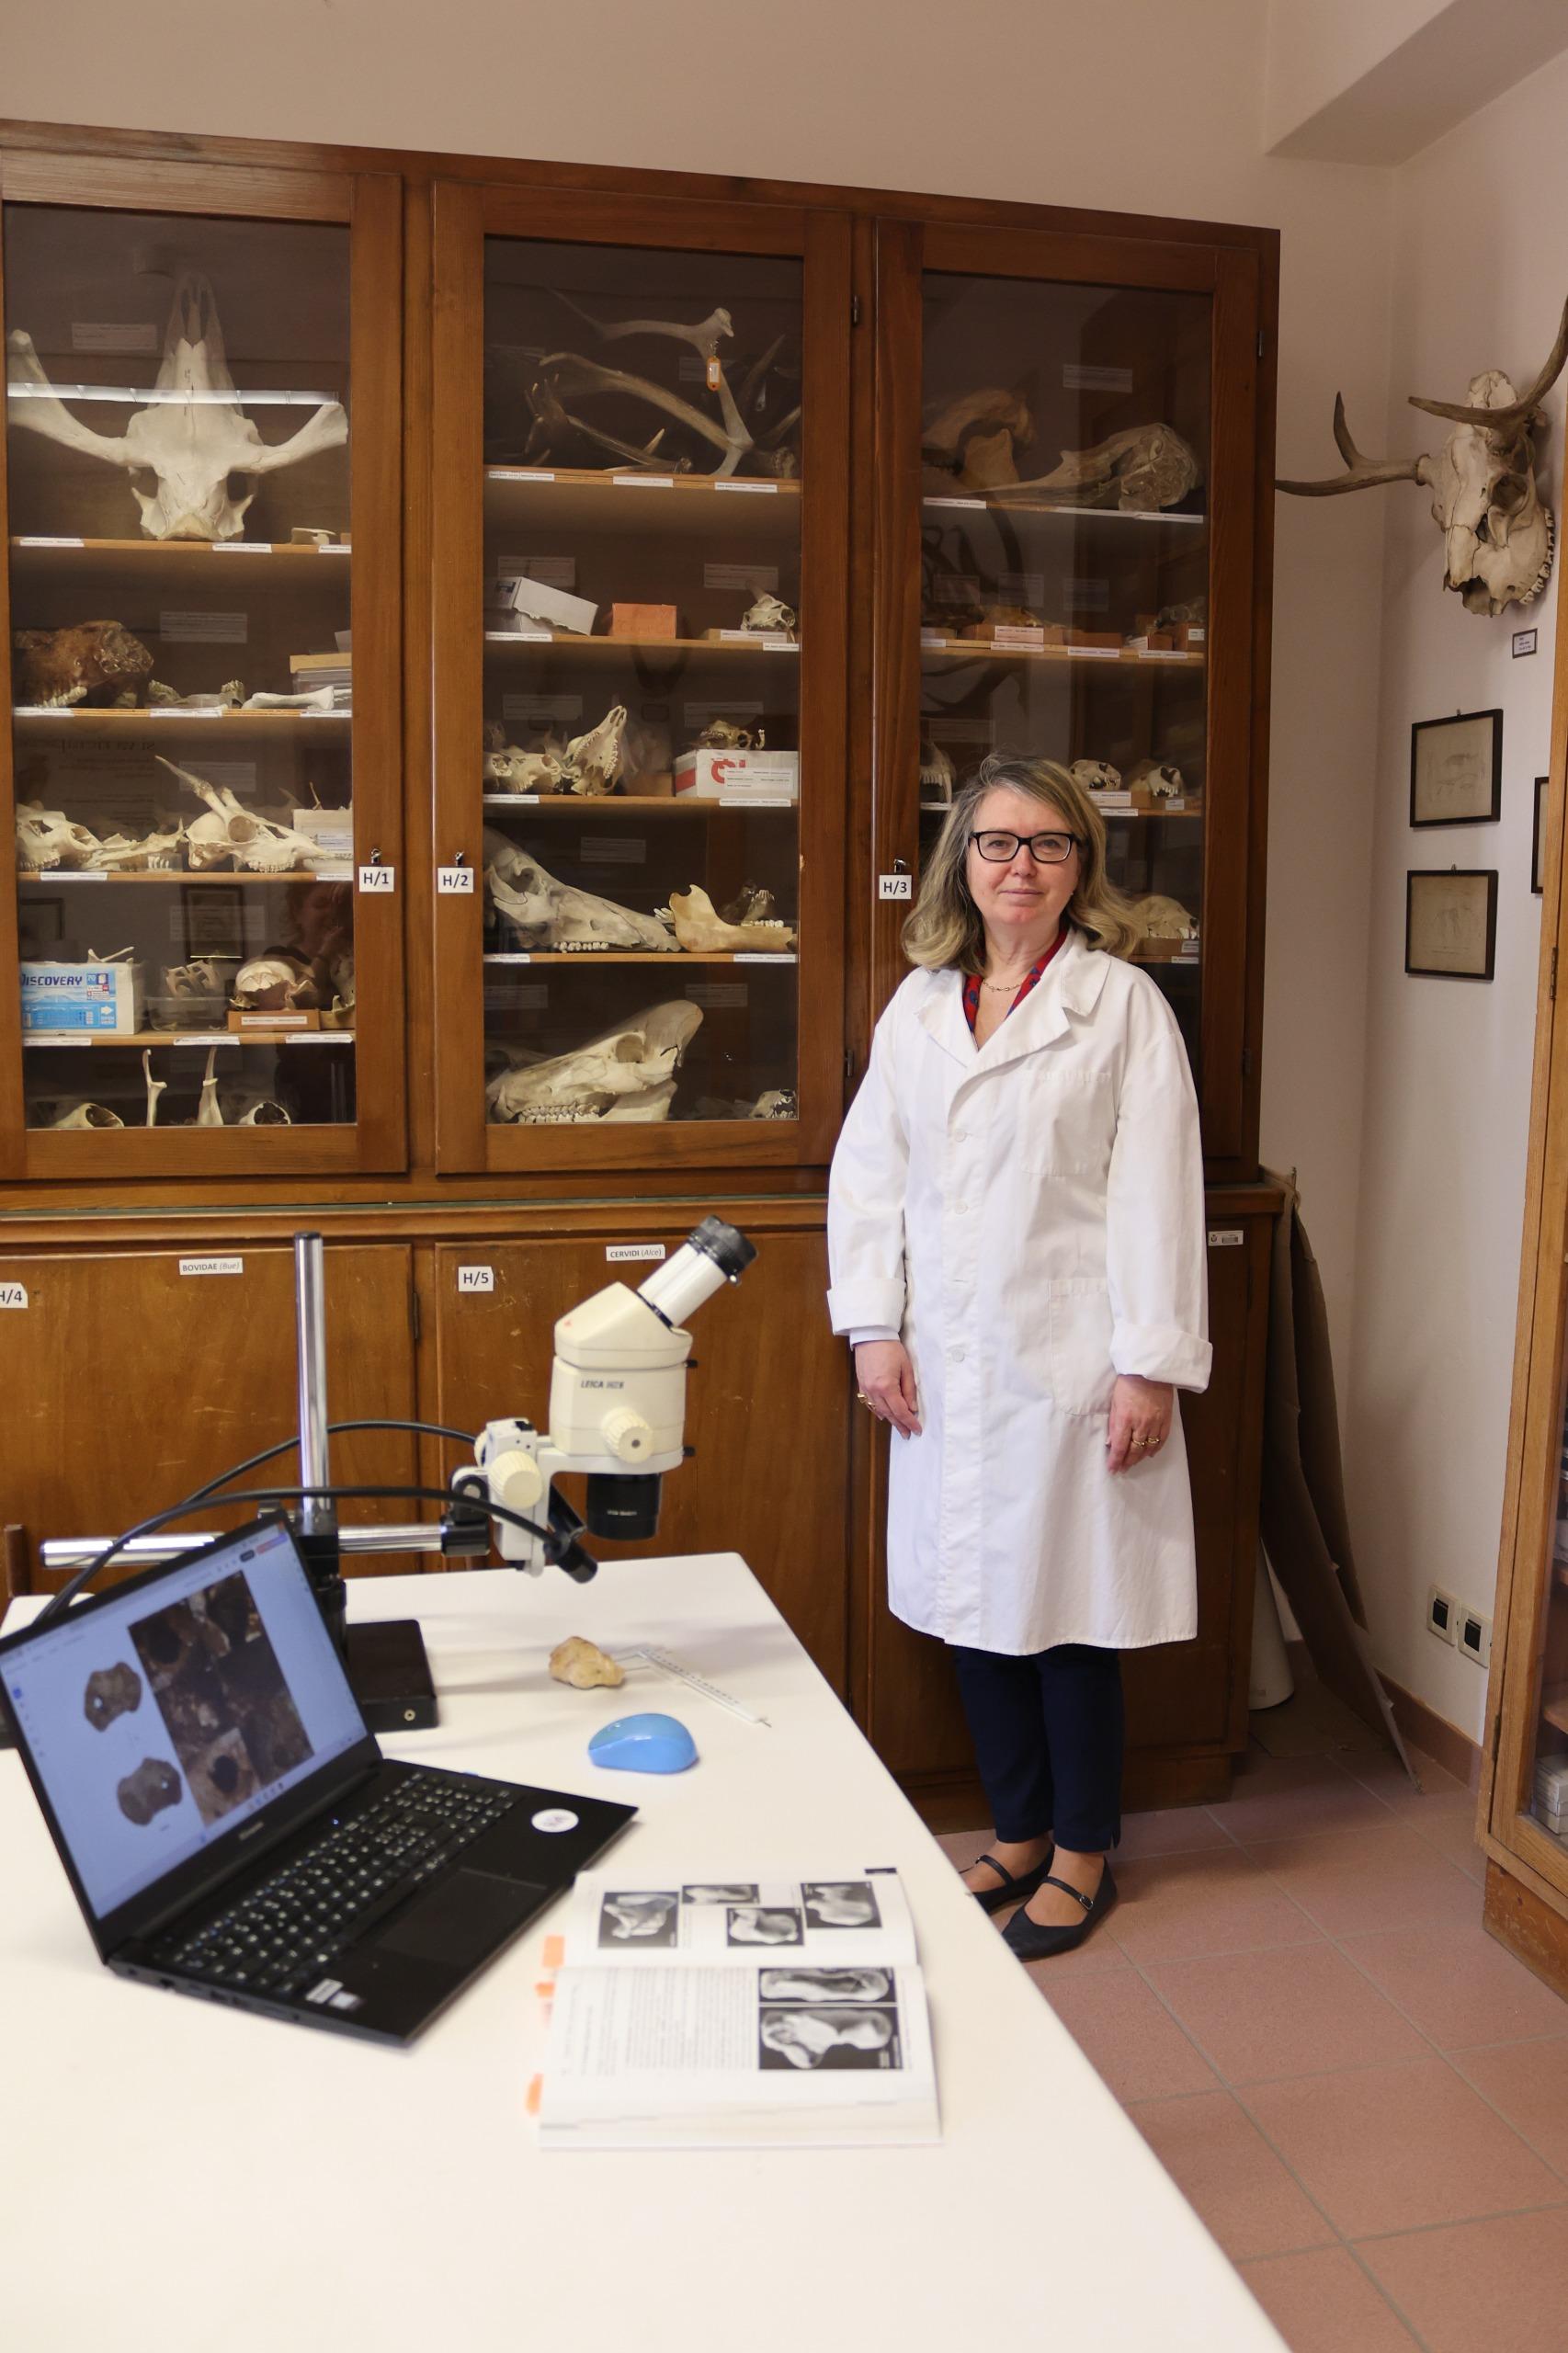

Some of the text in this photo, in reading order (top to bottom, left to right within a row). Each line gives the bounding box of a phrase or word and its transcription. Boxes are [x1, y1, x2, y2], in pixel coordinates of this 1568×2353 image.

[363, 870, 389, 887] H/1
[442, 873, 469, 889] H/2
[883, 880, 907, 895] H/3
[463, 1271, 489, 1287] H/5
